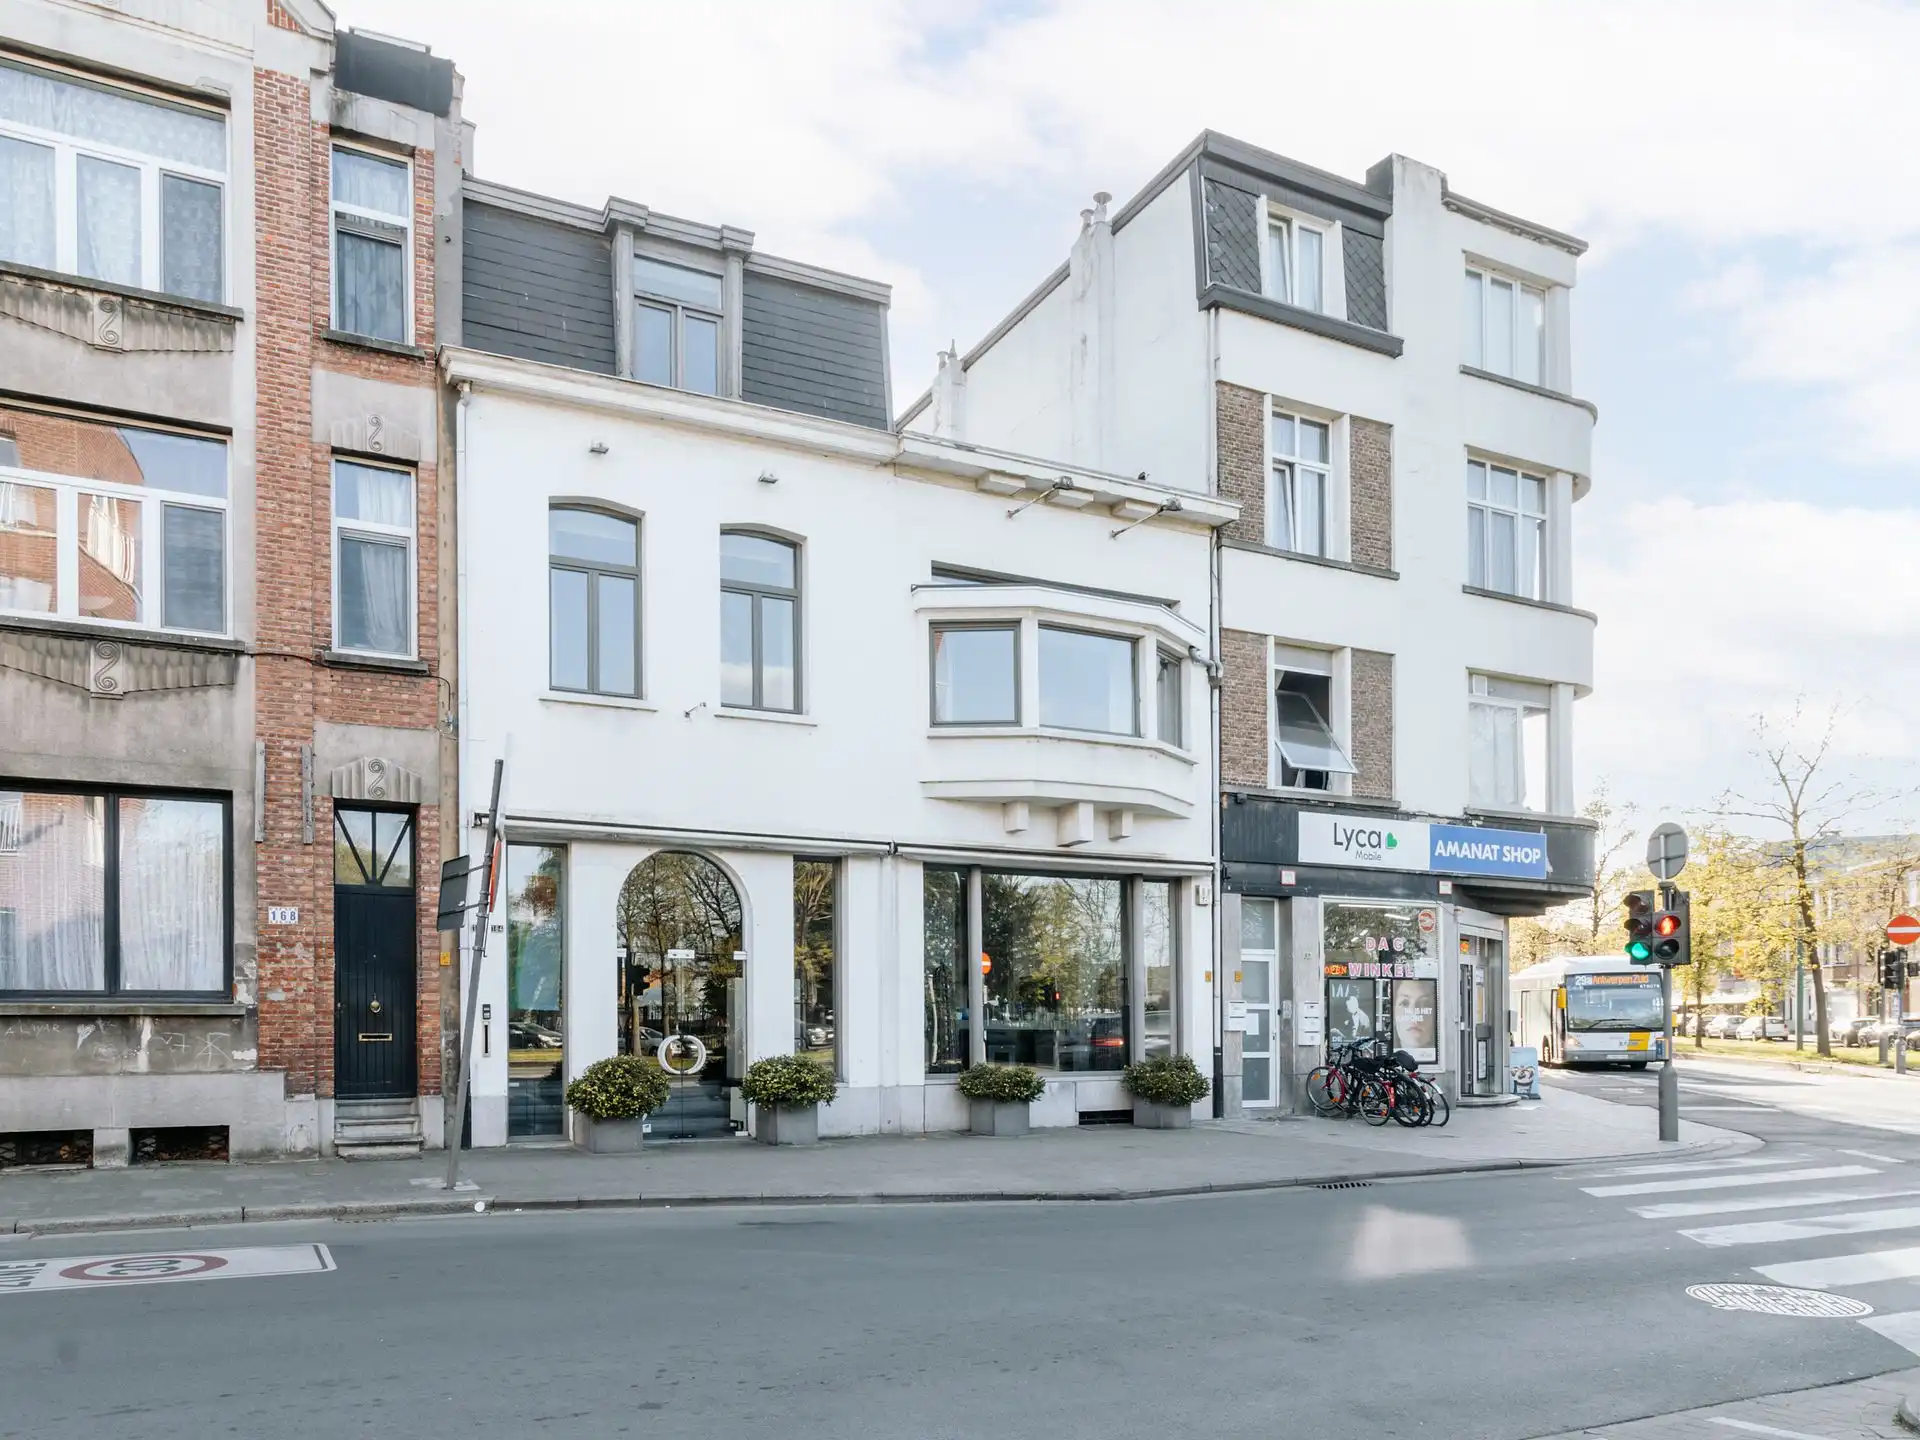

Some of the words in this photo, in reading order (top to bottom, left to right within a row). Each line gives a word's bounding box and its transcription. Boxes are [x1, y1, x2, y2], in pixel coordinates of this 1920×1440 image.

[1333, 822, 1381, 851] Lyca
[1355, 850, 1382, 861] Mobile
[1434, 839, 1500, 861] AMANAT
[1502, 845, 1541, 864] SHOP
[271, 910, 296, 921] 168
[1365, 937, 1404, 951] DAG
[1324, 965, 1347, 975] OPEN
[1348, 963, 1414, 977] WINKEL
[1592, 975, 1632, 985] Antwerpen
[107, 1259, 181, 1275] 30
